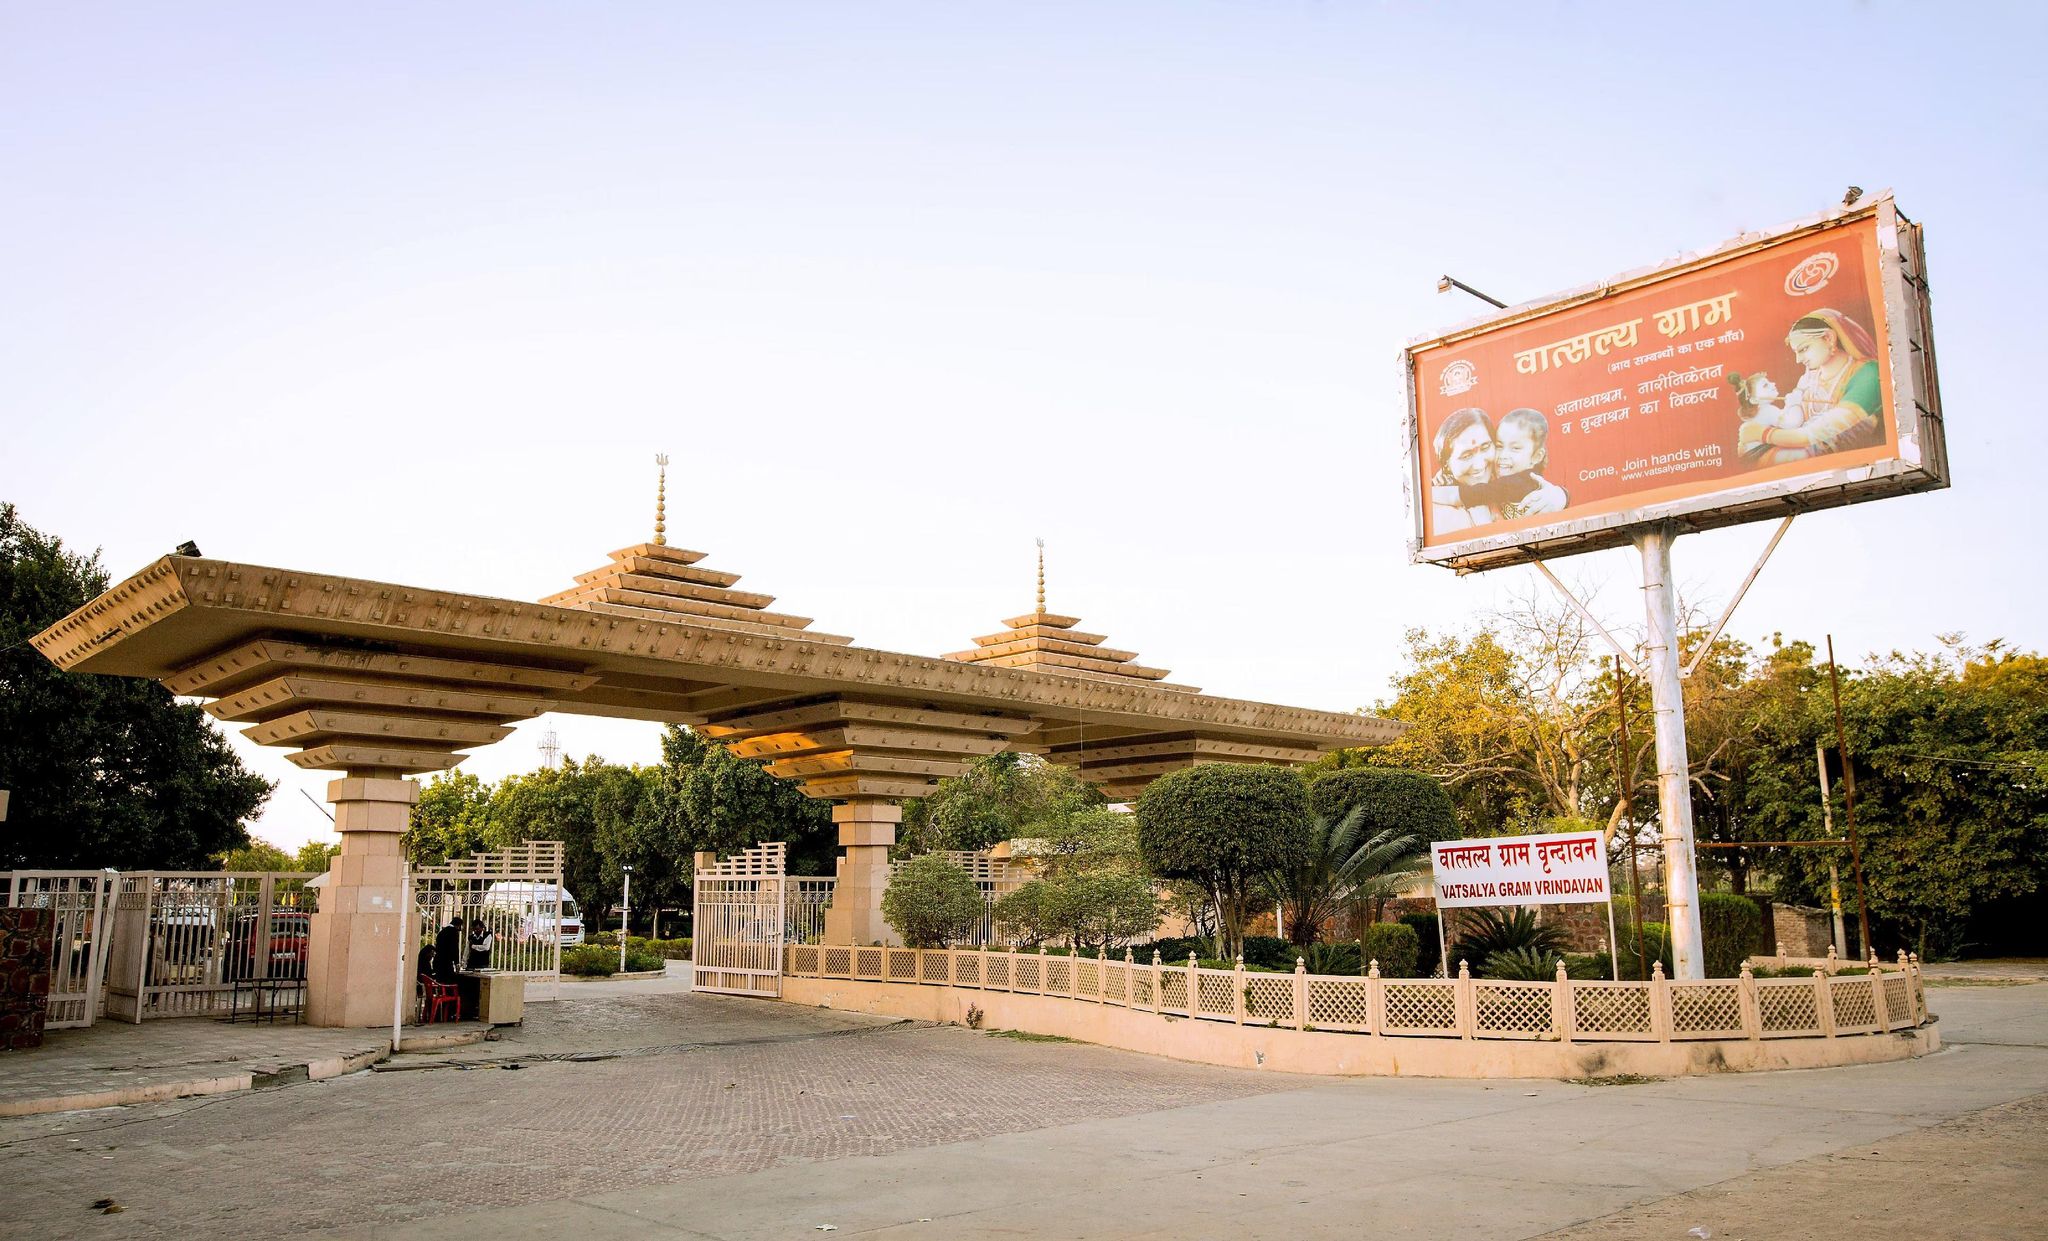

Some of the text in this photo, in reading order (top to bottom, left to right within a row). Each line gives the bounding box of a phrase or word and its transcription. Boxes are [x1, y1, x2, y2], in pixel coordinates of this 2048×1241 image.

[1513, 292, 1738, 375] वात्सल्य ग्राम
[1677, 343, 1692, 355] का
[1695, 337, 1715, 351] एक
[1554, 364, 1723, 416] अनाथाश्रम, नारीनिकेतन
[1561, 387, 1720, 434] व वृद्धाश्रम का विकल्प
[1579, 443, 1721, 482] Come, Join hands with
[1621, 457, 1723, 482] www.vatsalyagram.org
[1438, 838, 1597, 873] वात्सल्य ग्राम वृन्दावन
[1442, 878, 1603, 899] VATSALYA GRAM VRINDAVAN
